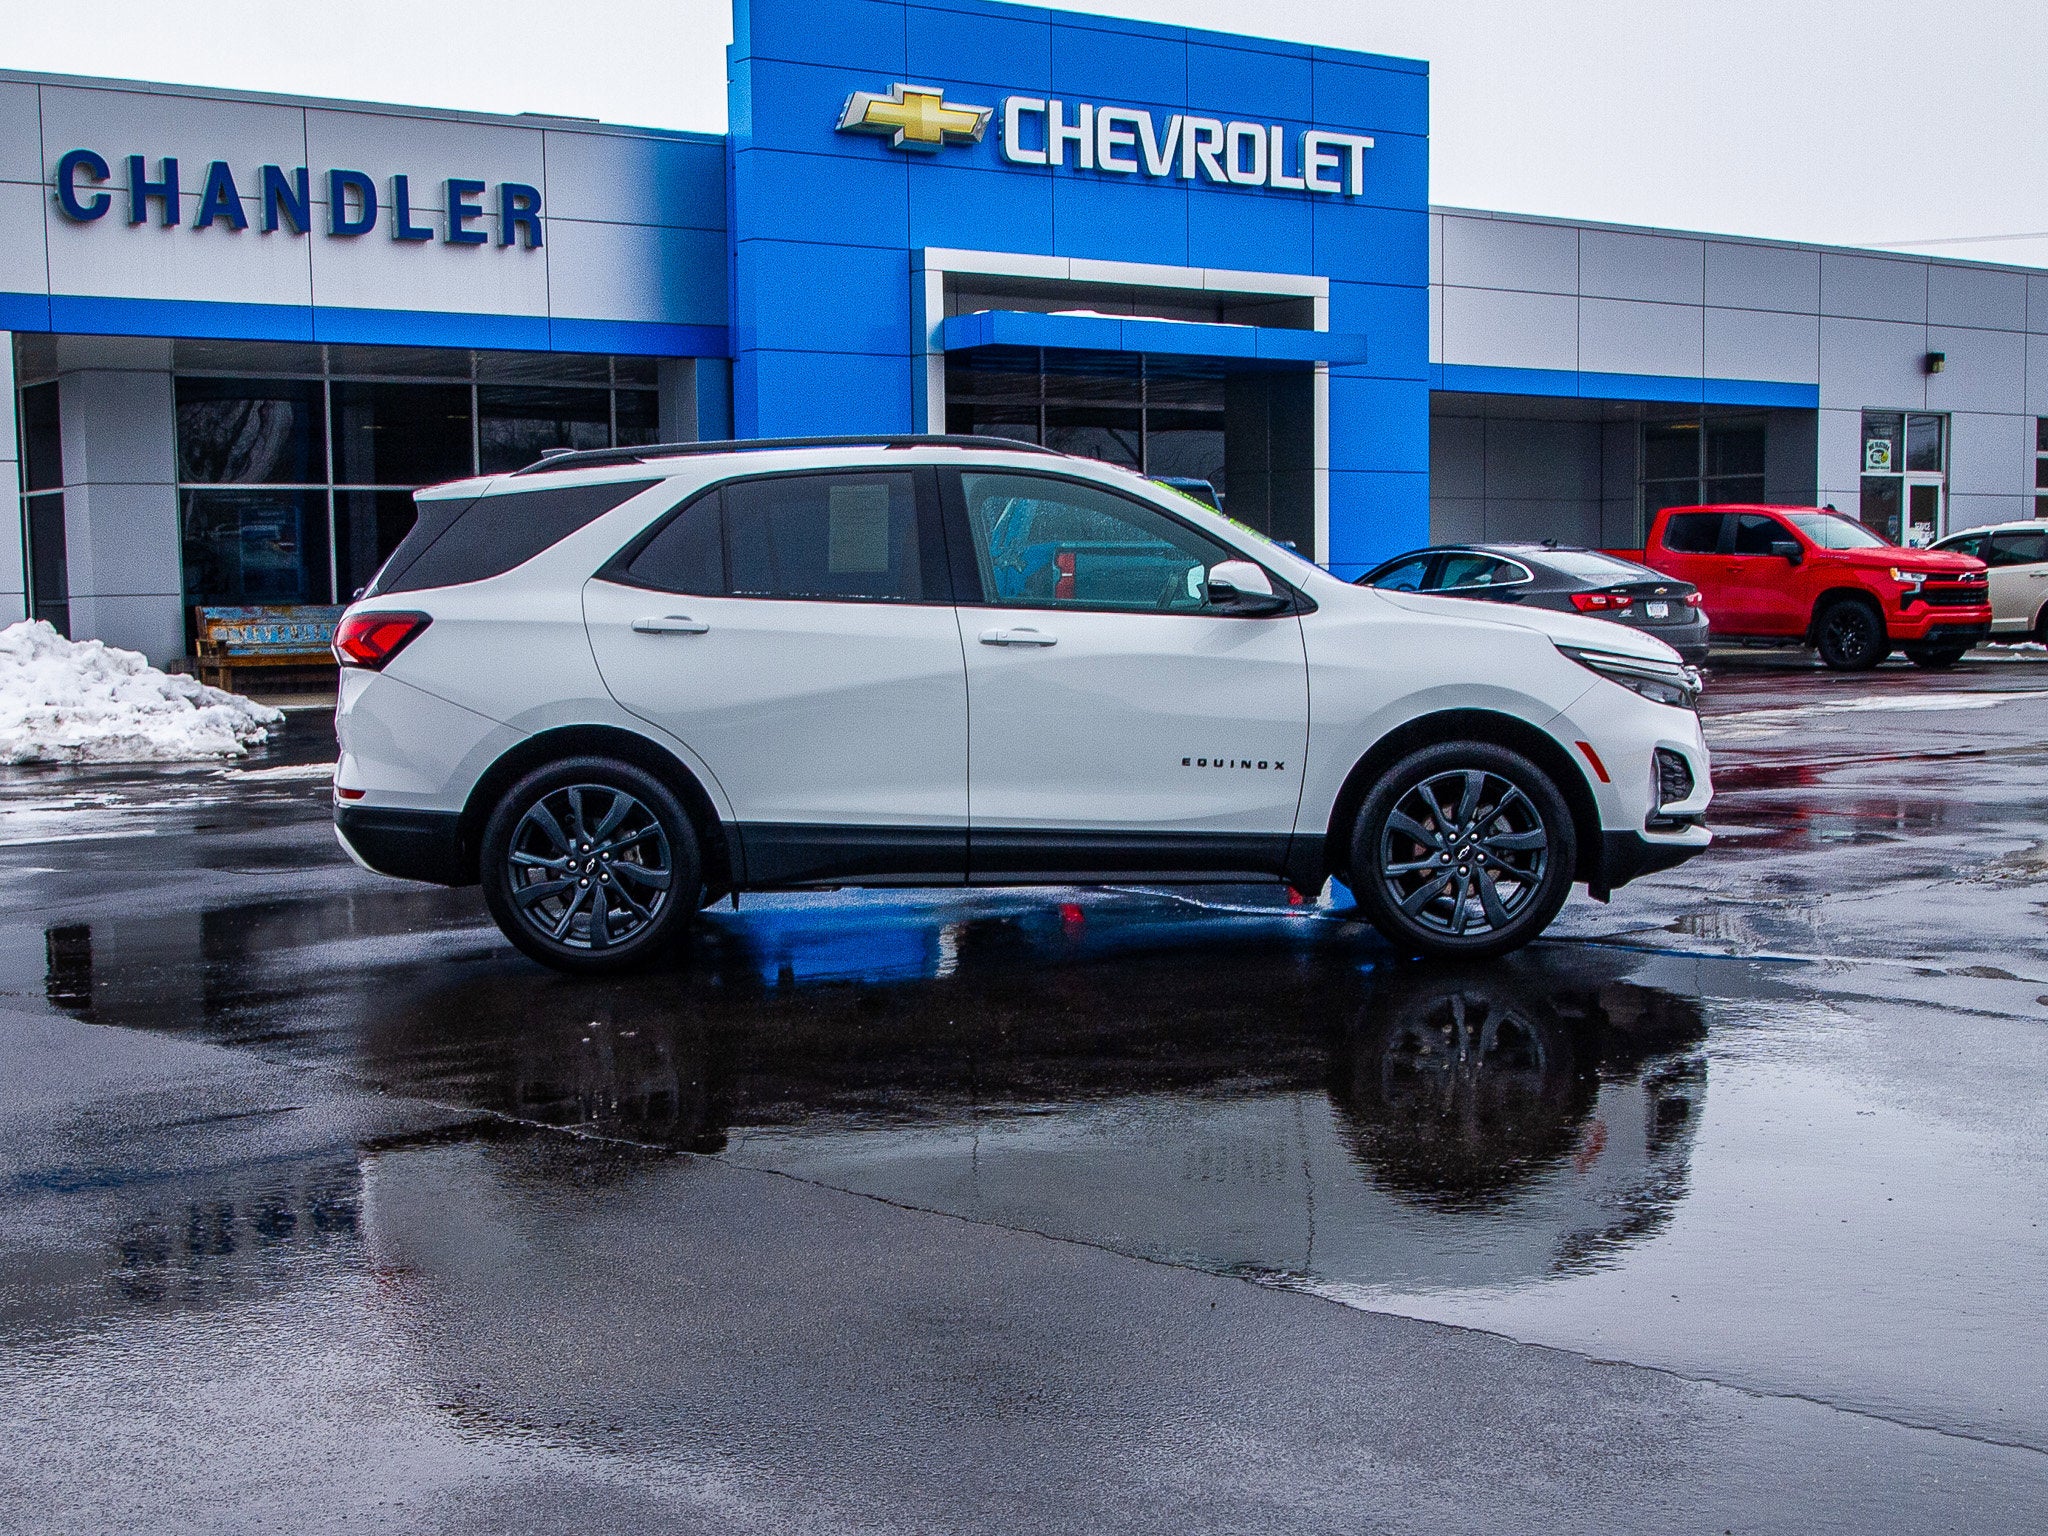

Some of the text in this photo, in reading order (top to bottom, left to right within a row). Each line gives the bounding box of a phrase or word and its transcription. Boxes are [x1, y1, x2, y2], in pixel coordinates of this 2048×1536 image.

[1001, 96, 1374, 196] CHEVROLET
[55, 149, 544, 248] CHANDLER
[1181, 757, 1285, 771] EQUINOX
